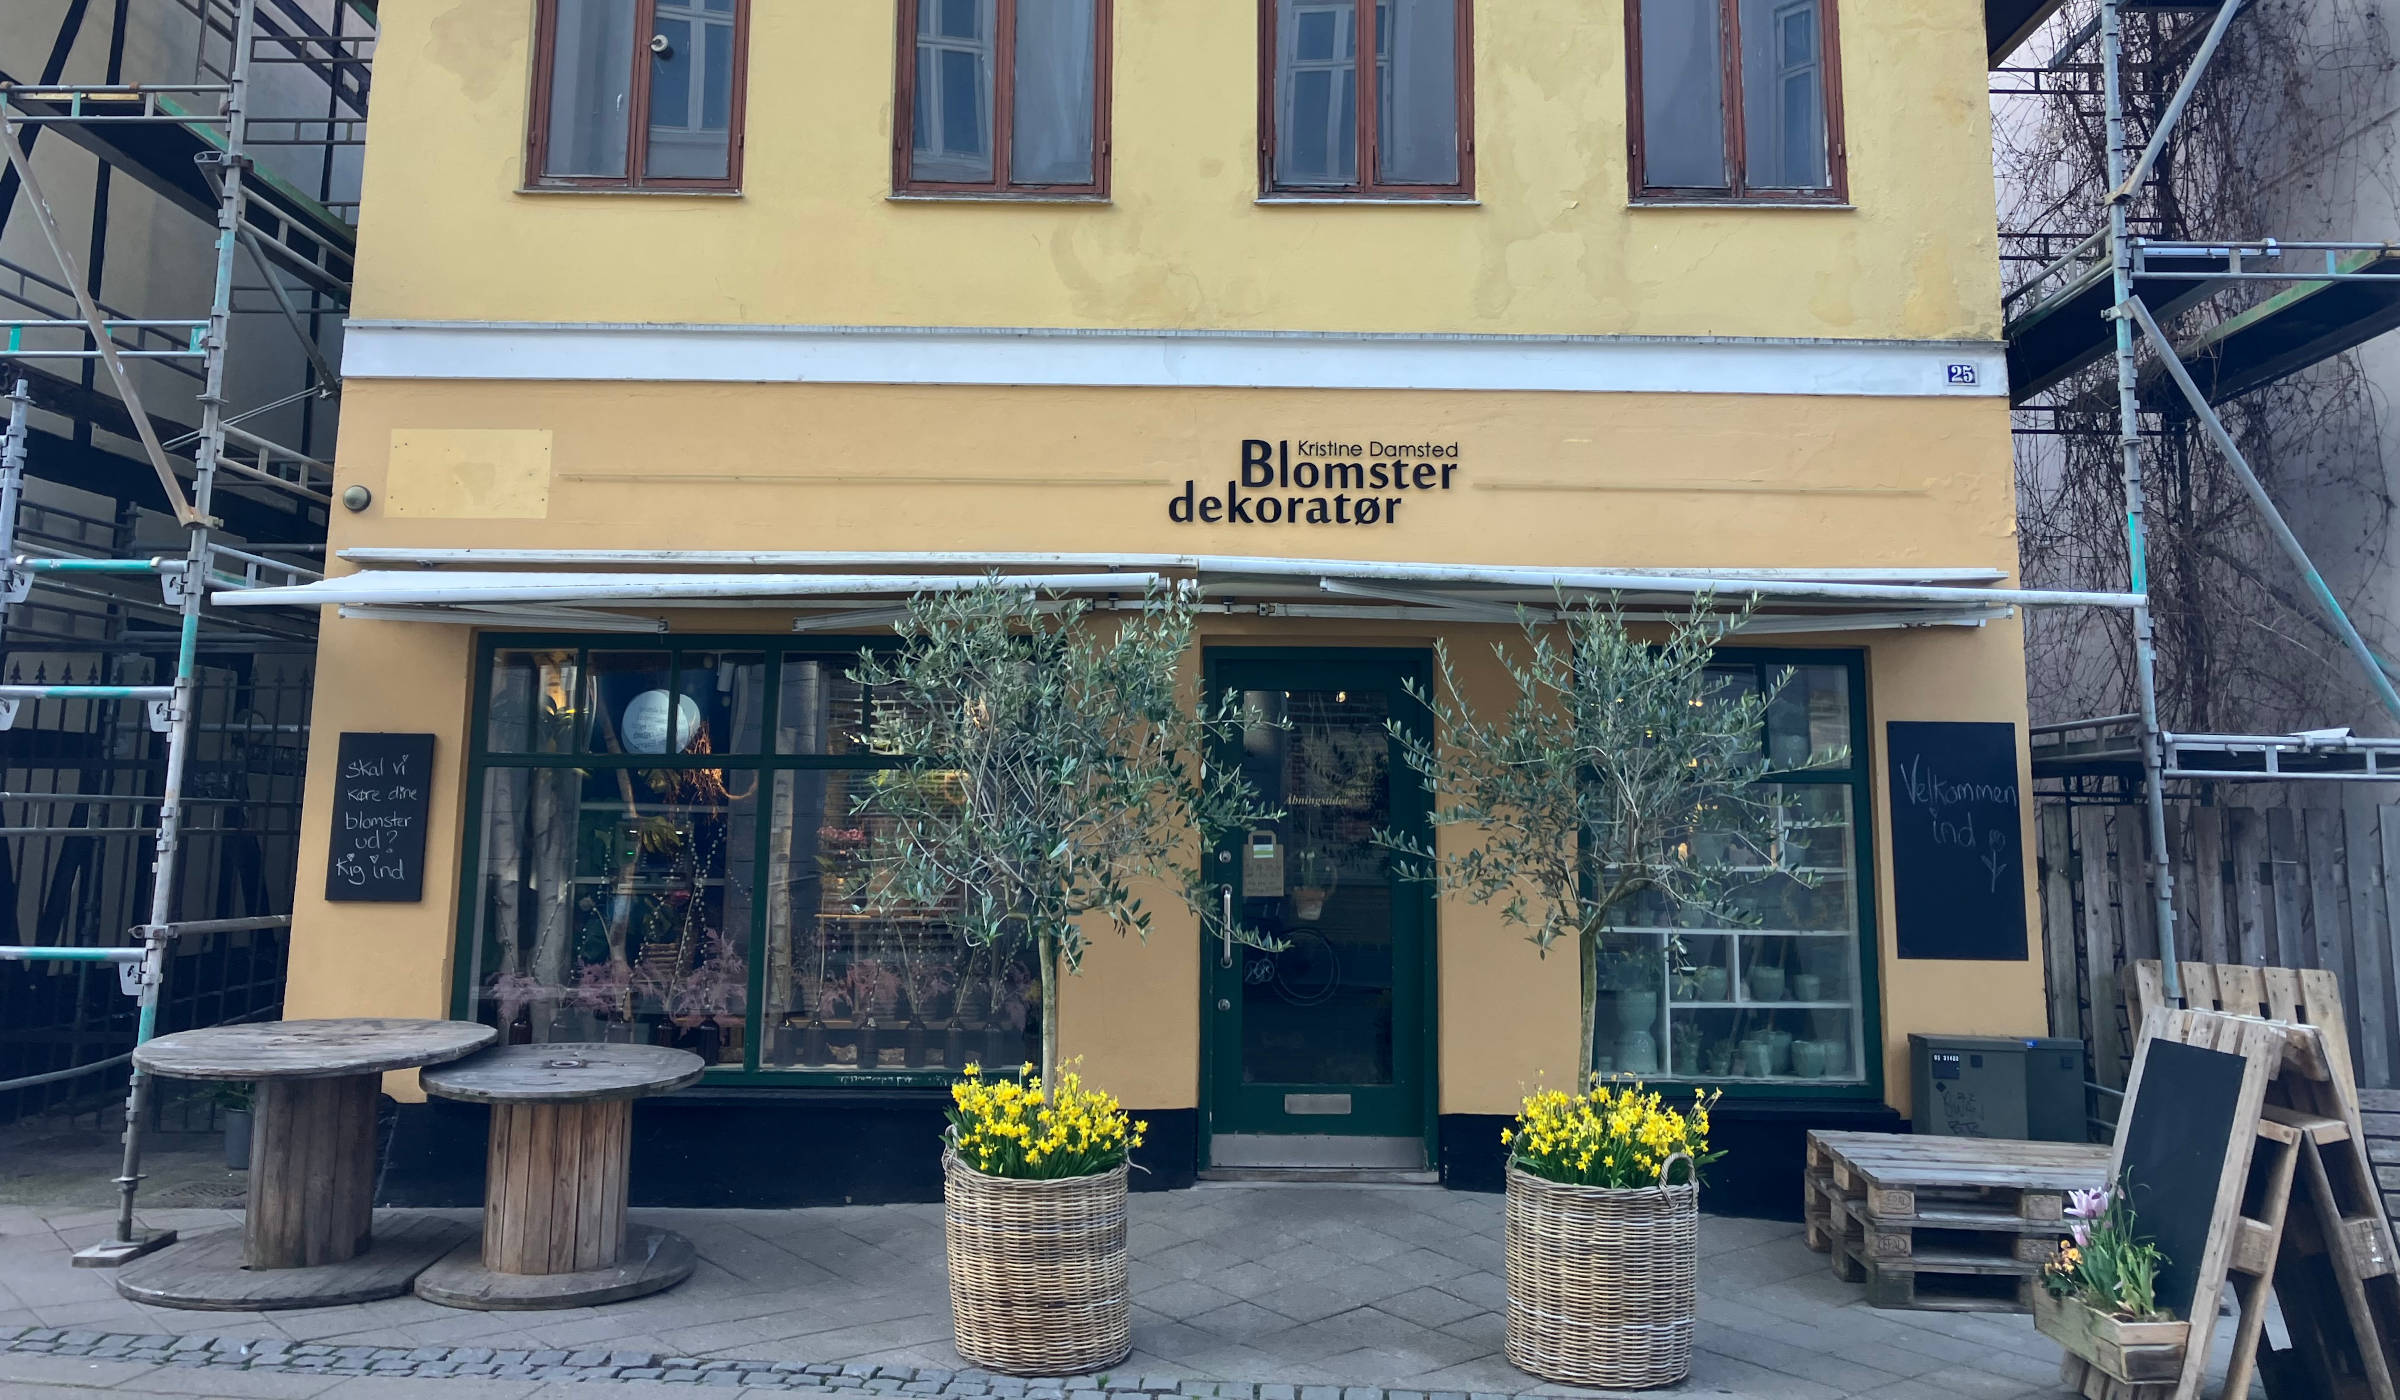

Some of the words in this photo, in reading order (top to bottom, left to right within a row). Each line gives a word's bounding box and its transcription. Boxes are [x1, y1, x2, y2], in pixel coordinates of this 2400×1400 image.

[1951, 366, 1973, 382] 25
[1298, 440, 1363, 457] Kristine
[1370, 441, 1459, 458] Damsted
[1240, 439, 1458, 490] Blomster
[1168, 479, 1402, 526] dekoratør
[388, 786, 417, 801] dine
[1900, 753, 2017, 807] Velkommen
[345, 811, 413, 830] blomster
[1929, 807, 1976, 848] ind
[369, 854, 405, 881] ind
